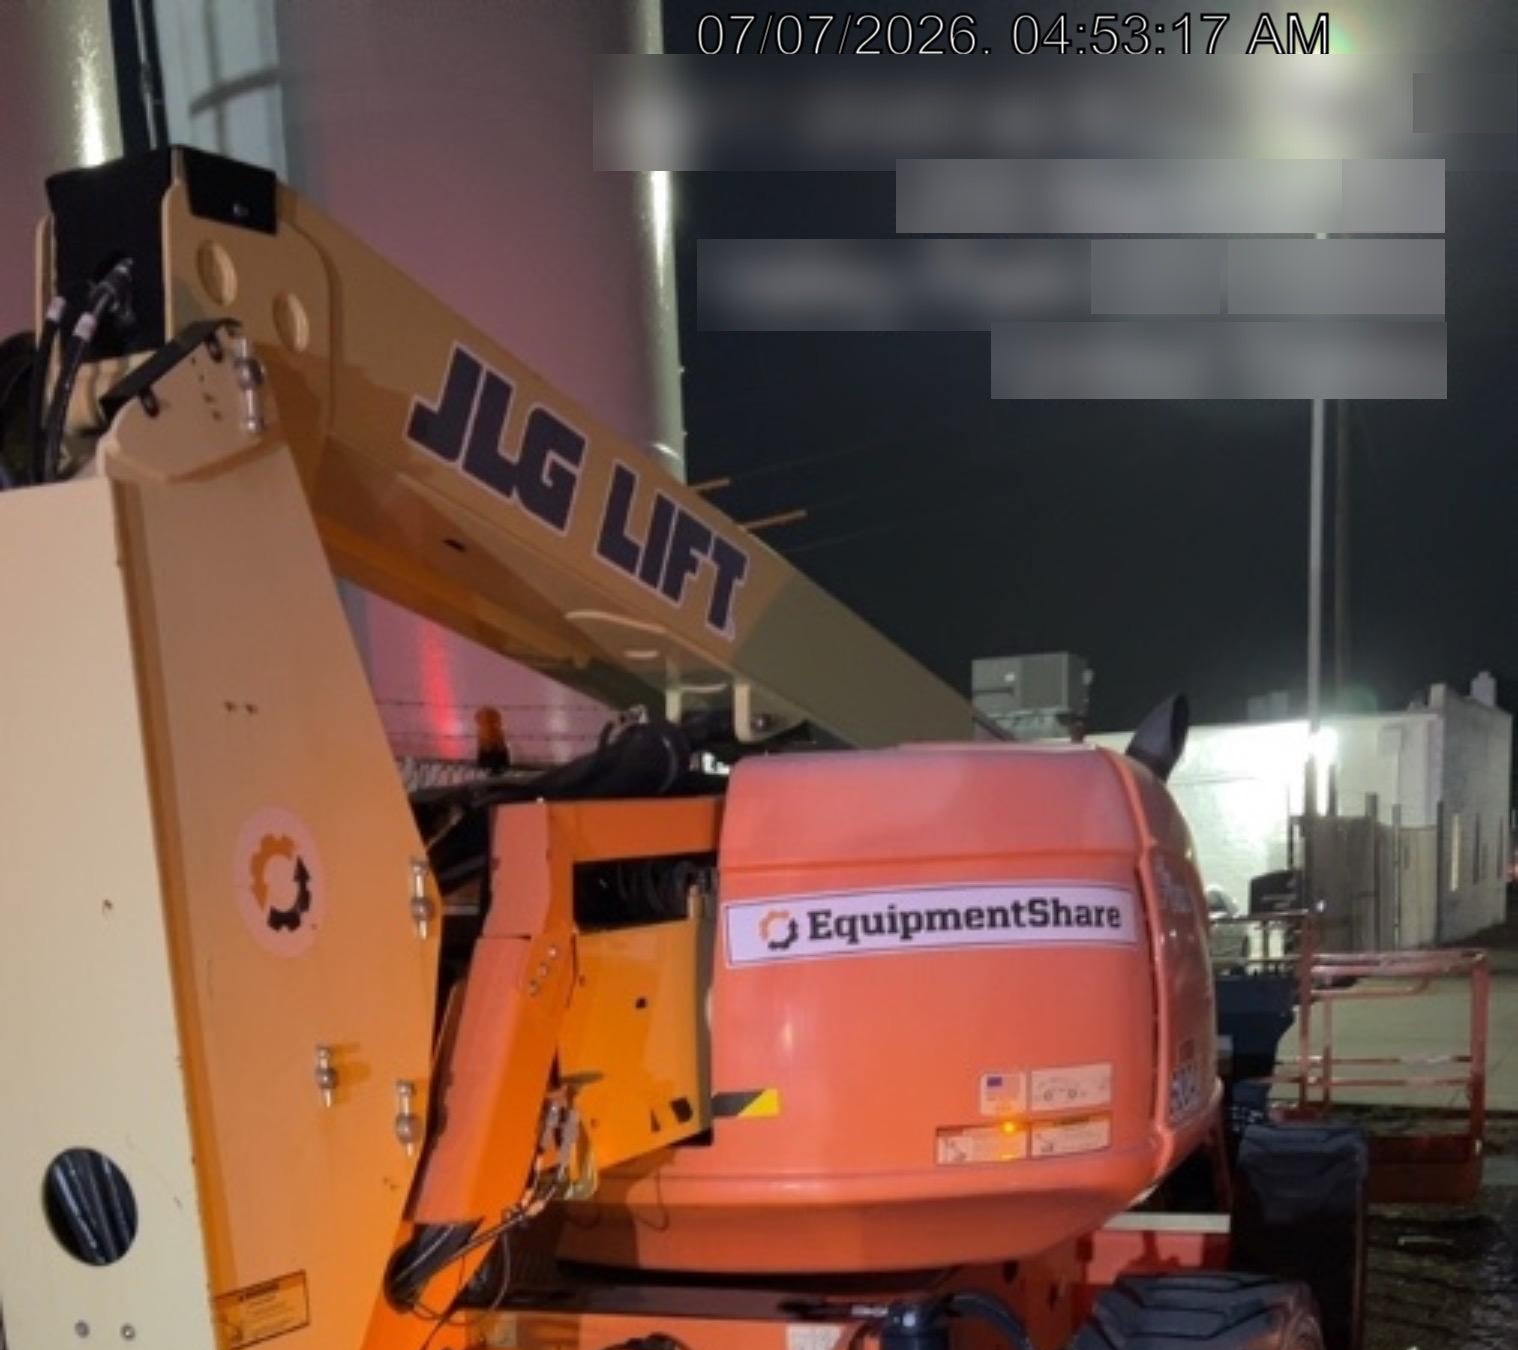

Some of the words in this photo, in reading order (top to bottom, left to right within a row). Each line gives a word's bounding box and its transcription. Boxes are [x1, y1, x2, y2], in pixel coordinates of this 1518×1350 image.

[405, 341, 588, 534] JLG
[595, 462, 749, 640] LIFT
[807, 897, 1121, 944] EquipmentShare
